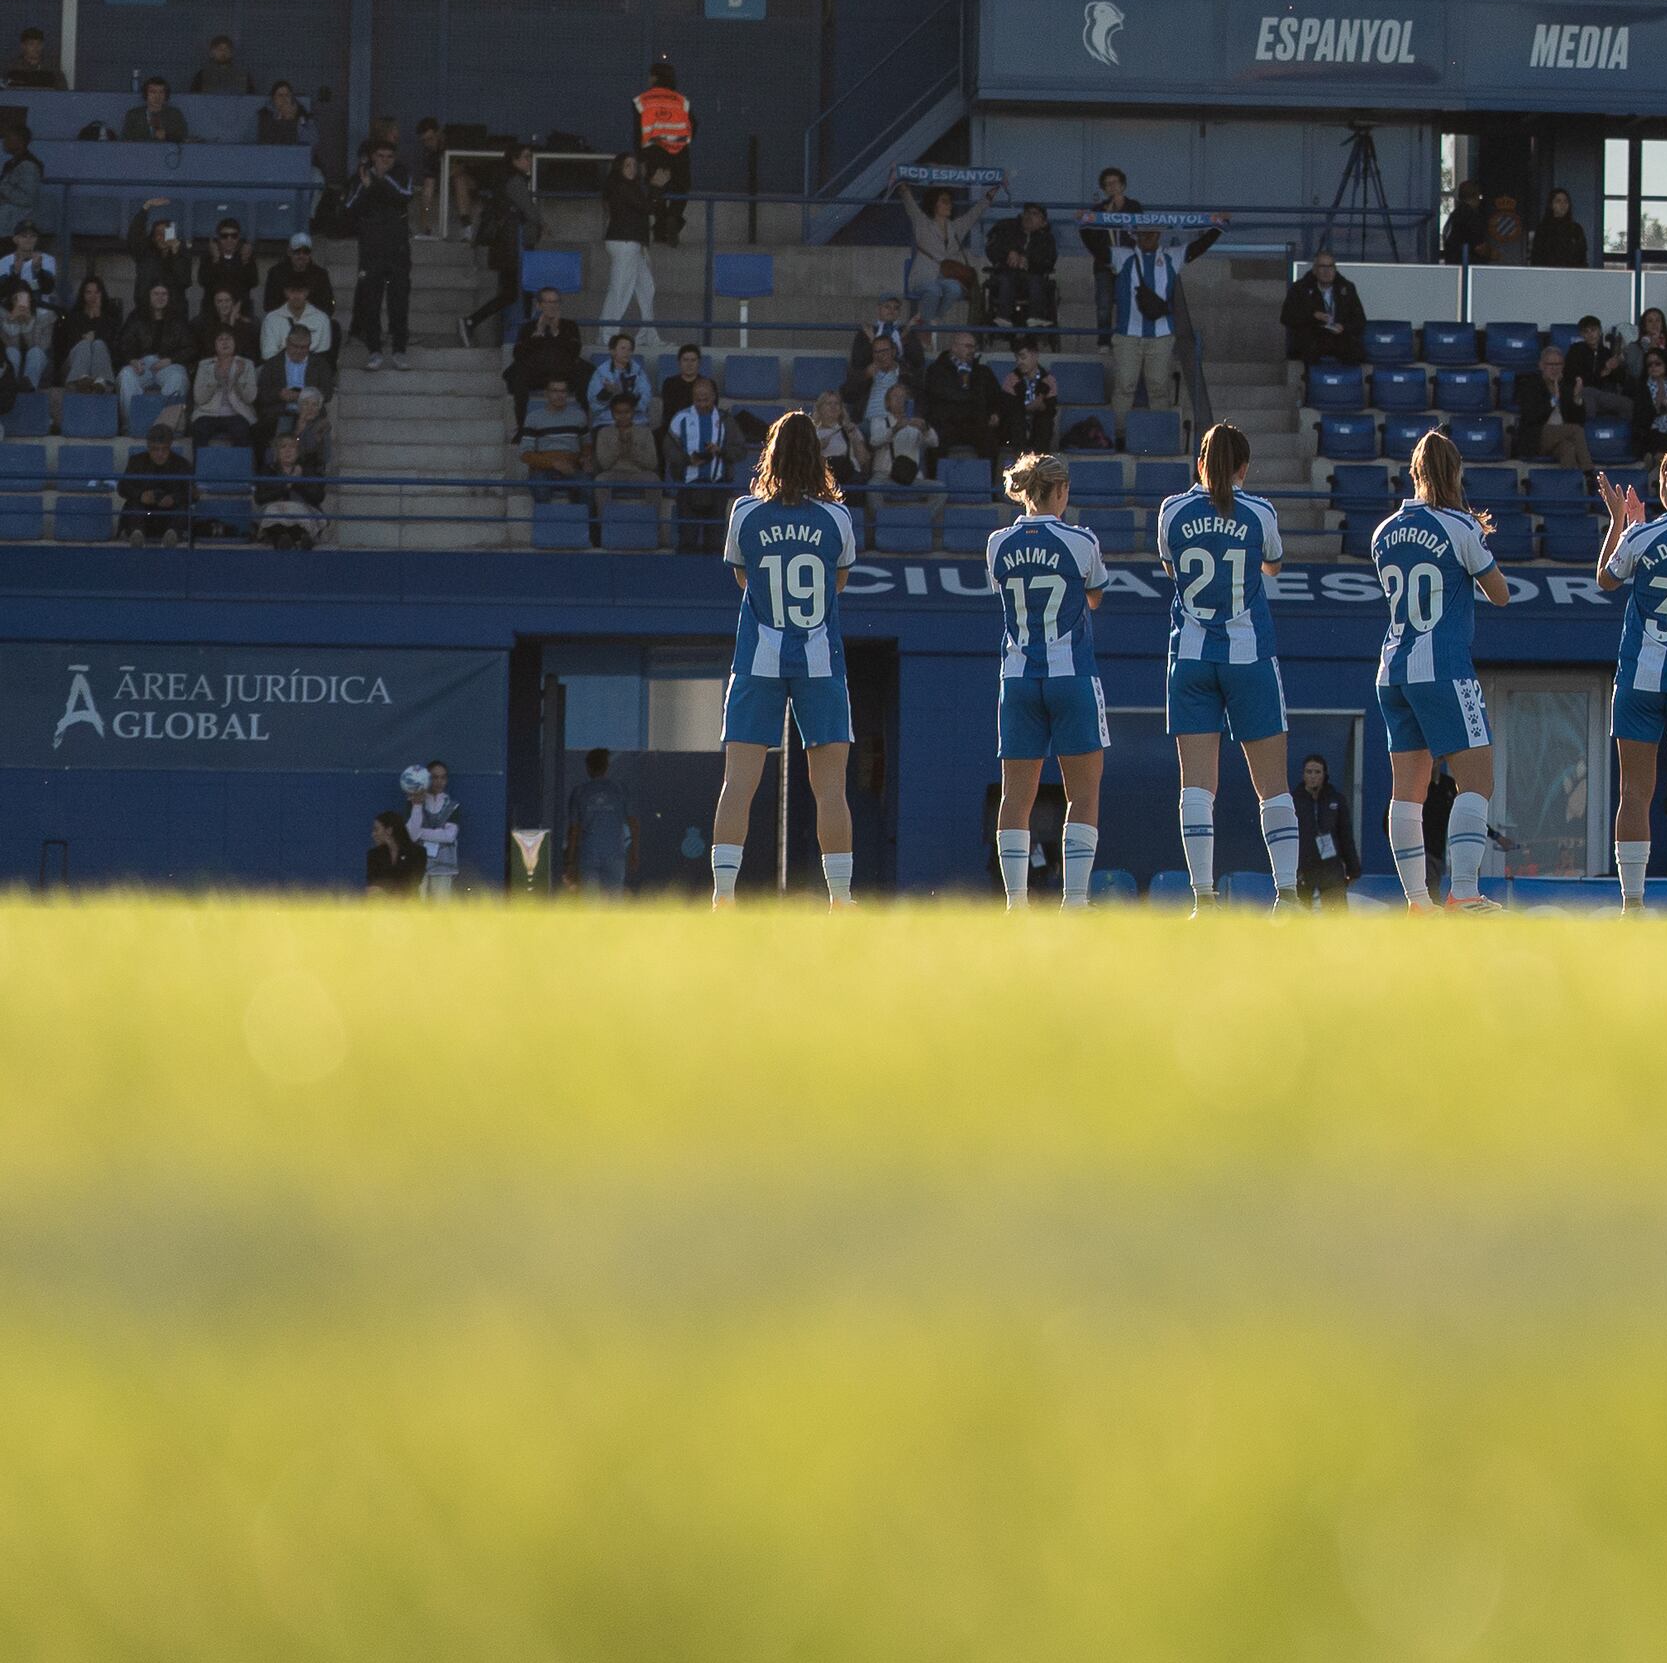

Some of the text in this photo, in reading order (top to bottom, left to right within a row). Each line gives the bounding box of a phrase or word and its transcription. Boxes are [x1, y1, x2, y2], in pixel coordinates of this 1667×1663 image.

[1255, 16, 1630, 71] ESPANYOL MEDIA
[899, 166, 1003, 183] RCD ESPANYOL
[1103, 212, 1204, 225] RCD ESPANYOL
[758, 523, 823, 547] ARANA
[1181, 516, 1249, 542] GUERRA
[1003, 547, 1061, 570] NAIMA
[1641, 554, 1658, 572] A.
[758, 553, 827, 629] 19
[1179, 547, 1247, 621] 21
[1381, 562, 1444, 636] 20
[1005, 574, 1068, 648] 17
[220, 668, 392, 708] JURÍDICA
[112, 711, 269, 741] GLOBAL
